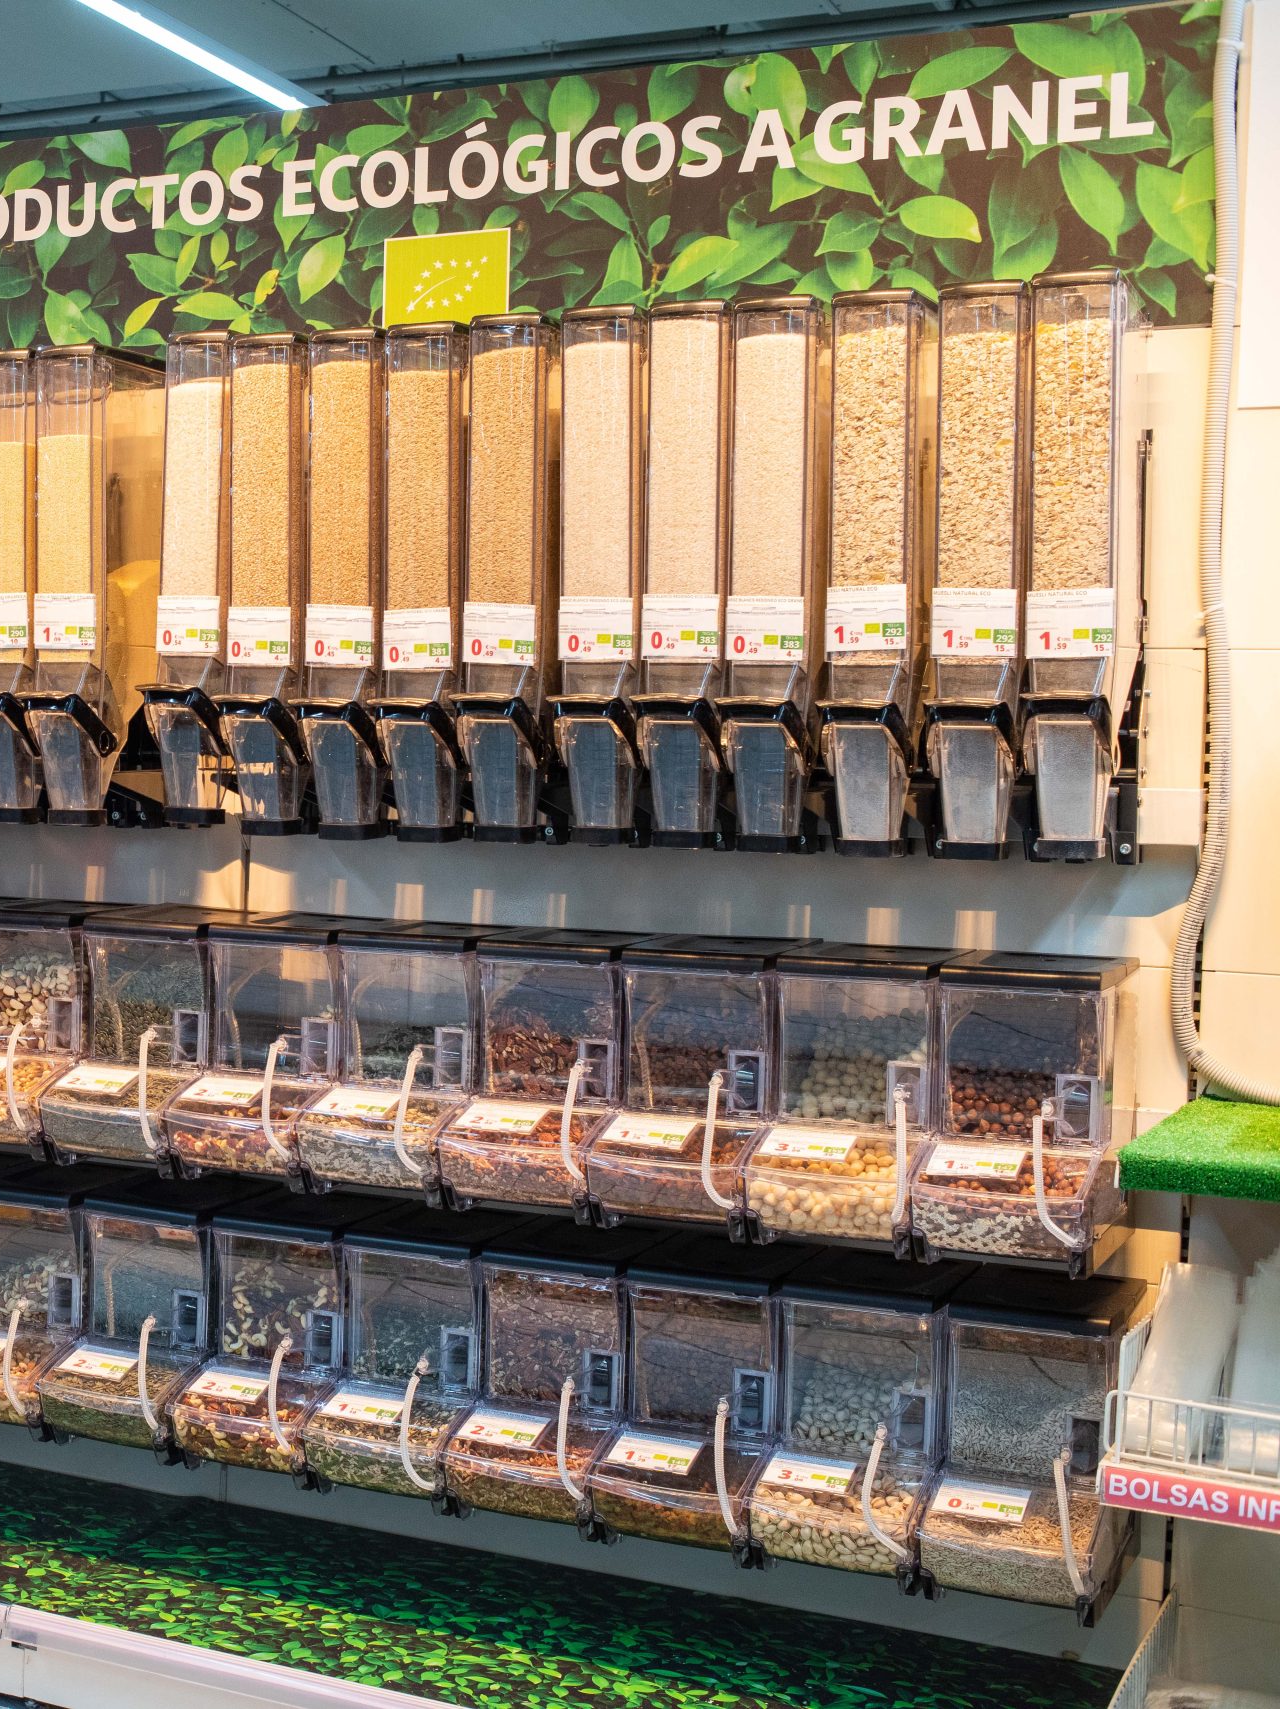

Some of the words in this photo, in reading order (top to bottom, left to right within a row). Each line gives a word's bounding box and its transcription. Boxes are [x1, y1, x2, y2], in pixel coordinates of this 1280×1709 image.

[279, 114, 722, 217] ECOLÓGICOS
[739, 108, 794, 173] A
[812, 71, 1155, 165] GRANEL
[43, 627, 50, 642] 1
[163, 630, 171, 645] 0
[651, 632, 662, 649] 0
[834, 626, 844, 643] 1
[943, 630, 953, 647] 1
[1040, 632, 1050, 649] 1
[232, 642, 240, 657] 0
[315, 640, 324, 656] 0
[472, 639, 482, 655] 0
[568, 635, 579, 652] 0
[733, 636, 745, 653] 0
[390, 647, 399, 662] 0
[777, 1470, 793, 1479] 3
[1108, 1474, 1229, 1513] BOLSAS
[948, 1498, 962, 1507] 0
